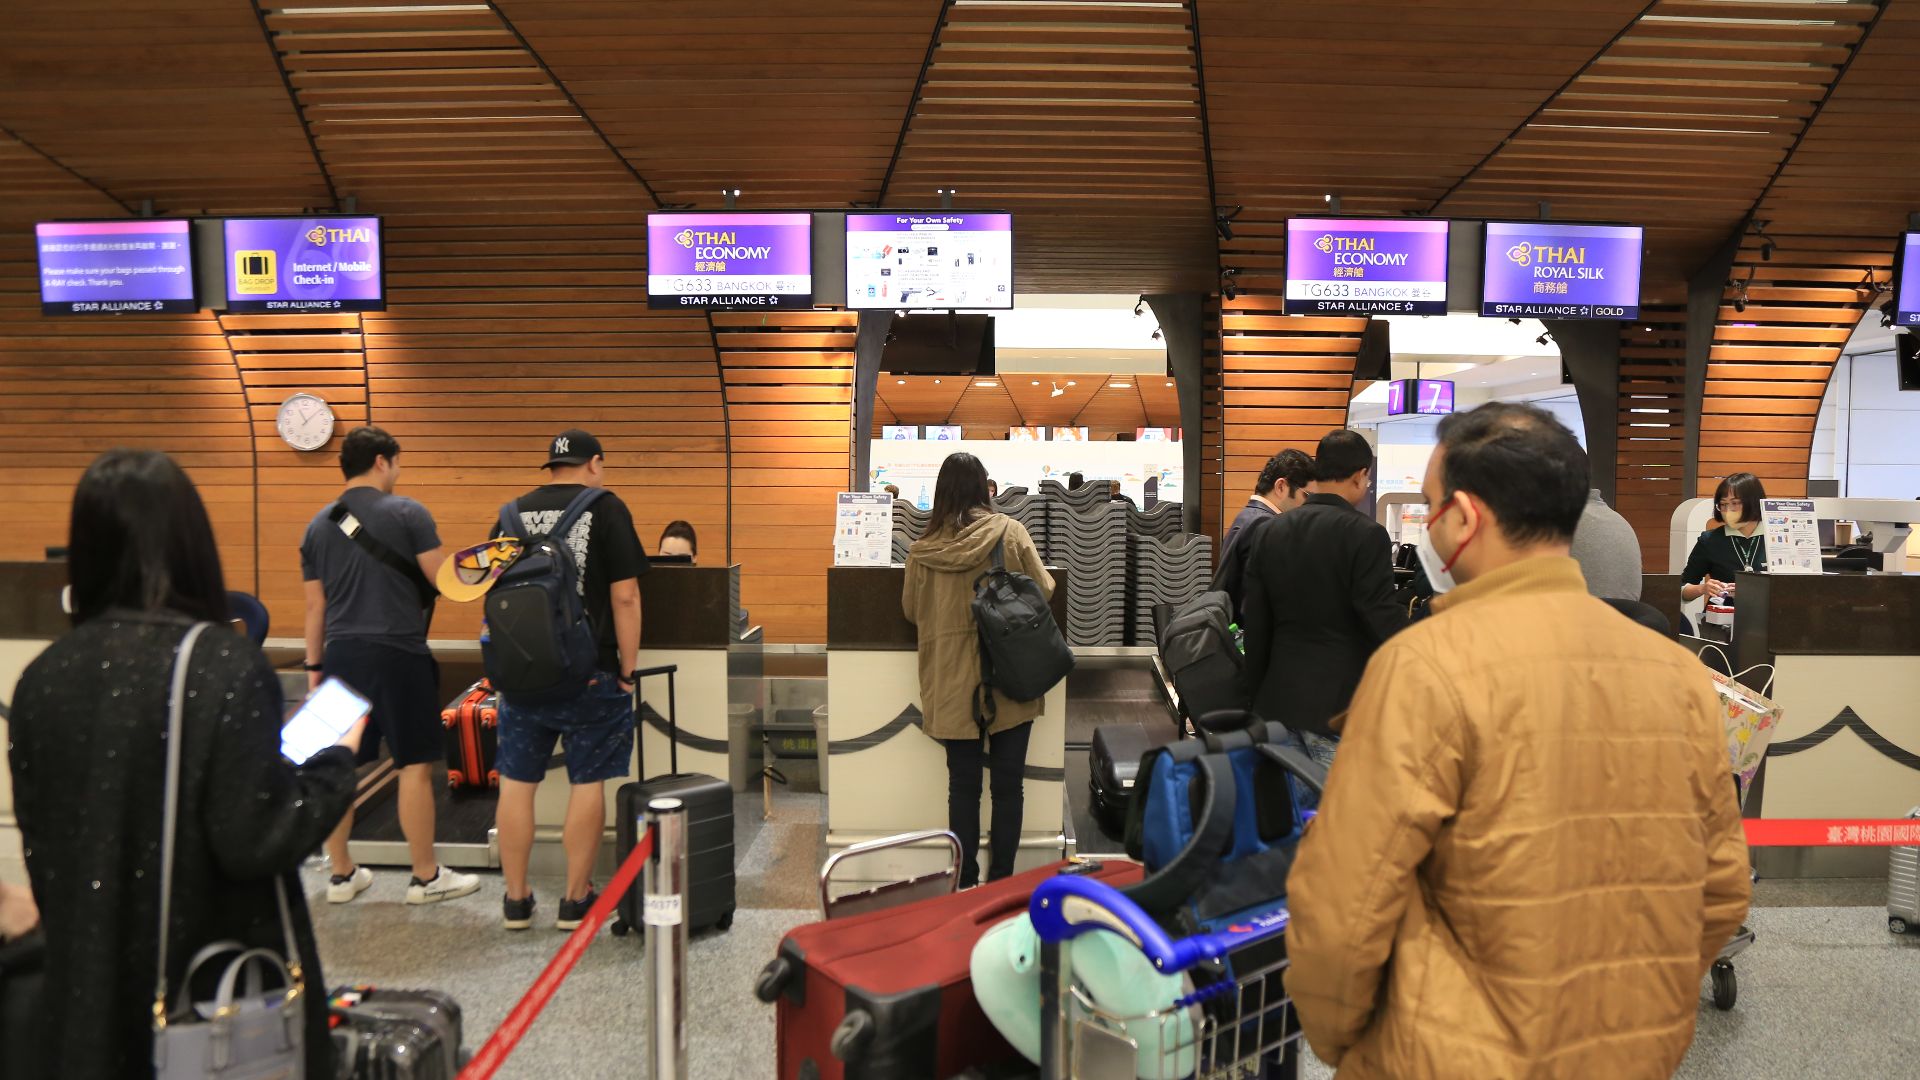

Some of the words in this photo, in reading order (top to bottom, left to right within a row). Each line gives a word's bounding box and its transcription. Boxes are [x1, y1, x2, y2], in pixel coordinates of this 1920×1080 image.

[327, 228, 370, 242] THAI
[695, 232, 736, 245] THAI
[1334, 238, 1374, 251] THAI
[696, 247, 771, 259] ECONOMY
[1533, 246, 1585, 264] THAI
[1334, 253, 1408, 266] ECONOMY
[100, 267, 114, 276] your
[116, 266, 132, 275] bags
[134, 266, 156, 275] passed
[158, 265, 185, 275] through
[293, 262, 331, 272] Internet
[339, 262, 372, 271] Mobile
[695, 261, 726, 272] 經濟艙
[1333, 267, 1364, 278] 經濟艙
[1534, 267, 1575, 278] ROYAL
[1577, 268, 1604, 280] SILK
[293, 275, 334, 285] Check-in
[666, 279, 712, 291] TG633
[717, 282, 772, 291] BANGKOK
[1302, 284, 1349, 297] TG633
[1354, 288, 1408, 297] BANGKOK
[1533, 282, 1568, 294] 商務艙
[72, 303, 99, 312] STAR
[102, 302, 152, 311] ALLIANCE
[1318, 302, 1345, 310] STAR
[1348, 302, 1401, 311] ALLIANCE
[1496, 305, 1522, 313] STAR
[1525, 306, 1576, 314] ALLIANCE
[1596, 308, 1624, 316] GOLD
[1428, 384, 1441, 410] 7
